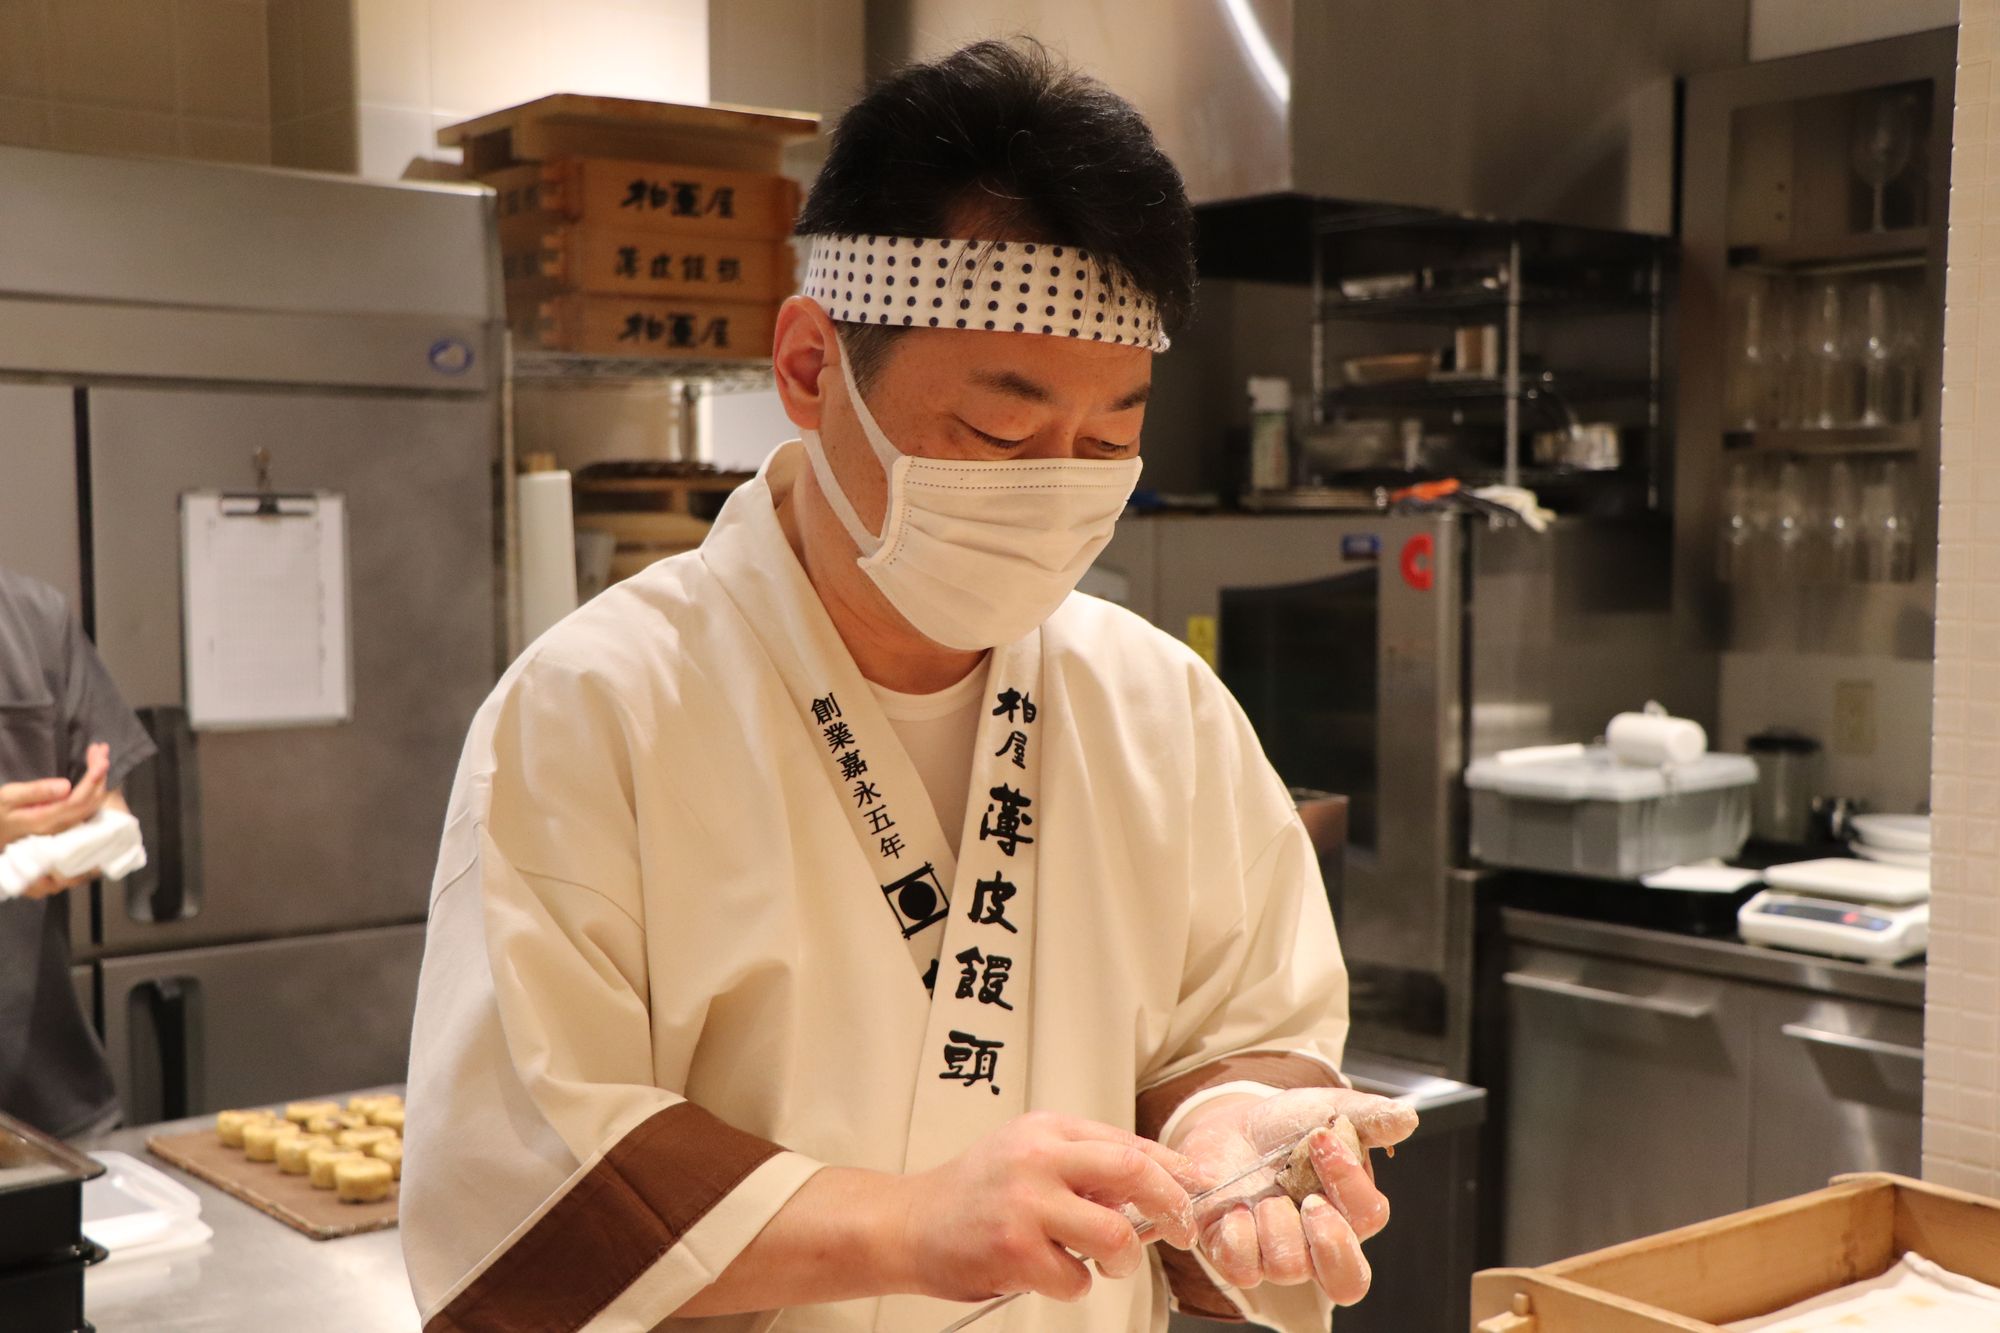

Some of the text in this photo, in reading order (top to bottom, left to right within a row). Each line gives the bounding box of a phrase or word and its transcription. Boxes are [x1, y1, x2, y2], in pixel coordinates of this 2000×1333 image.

[810, 692, 906, 860] 創業嘉永五年
